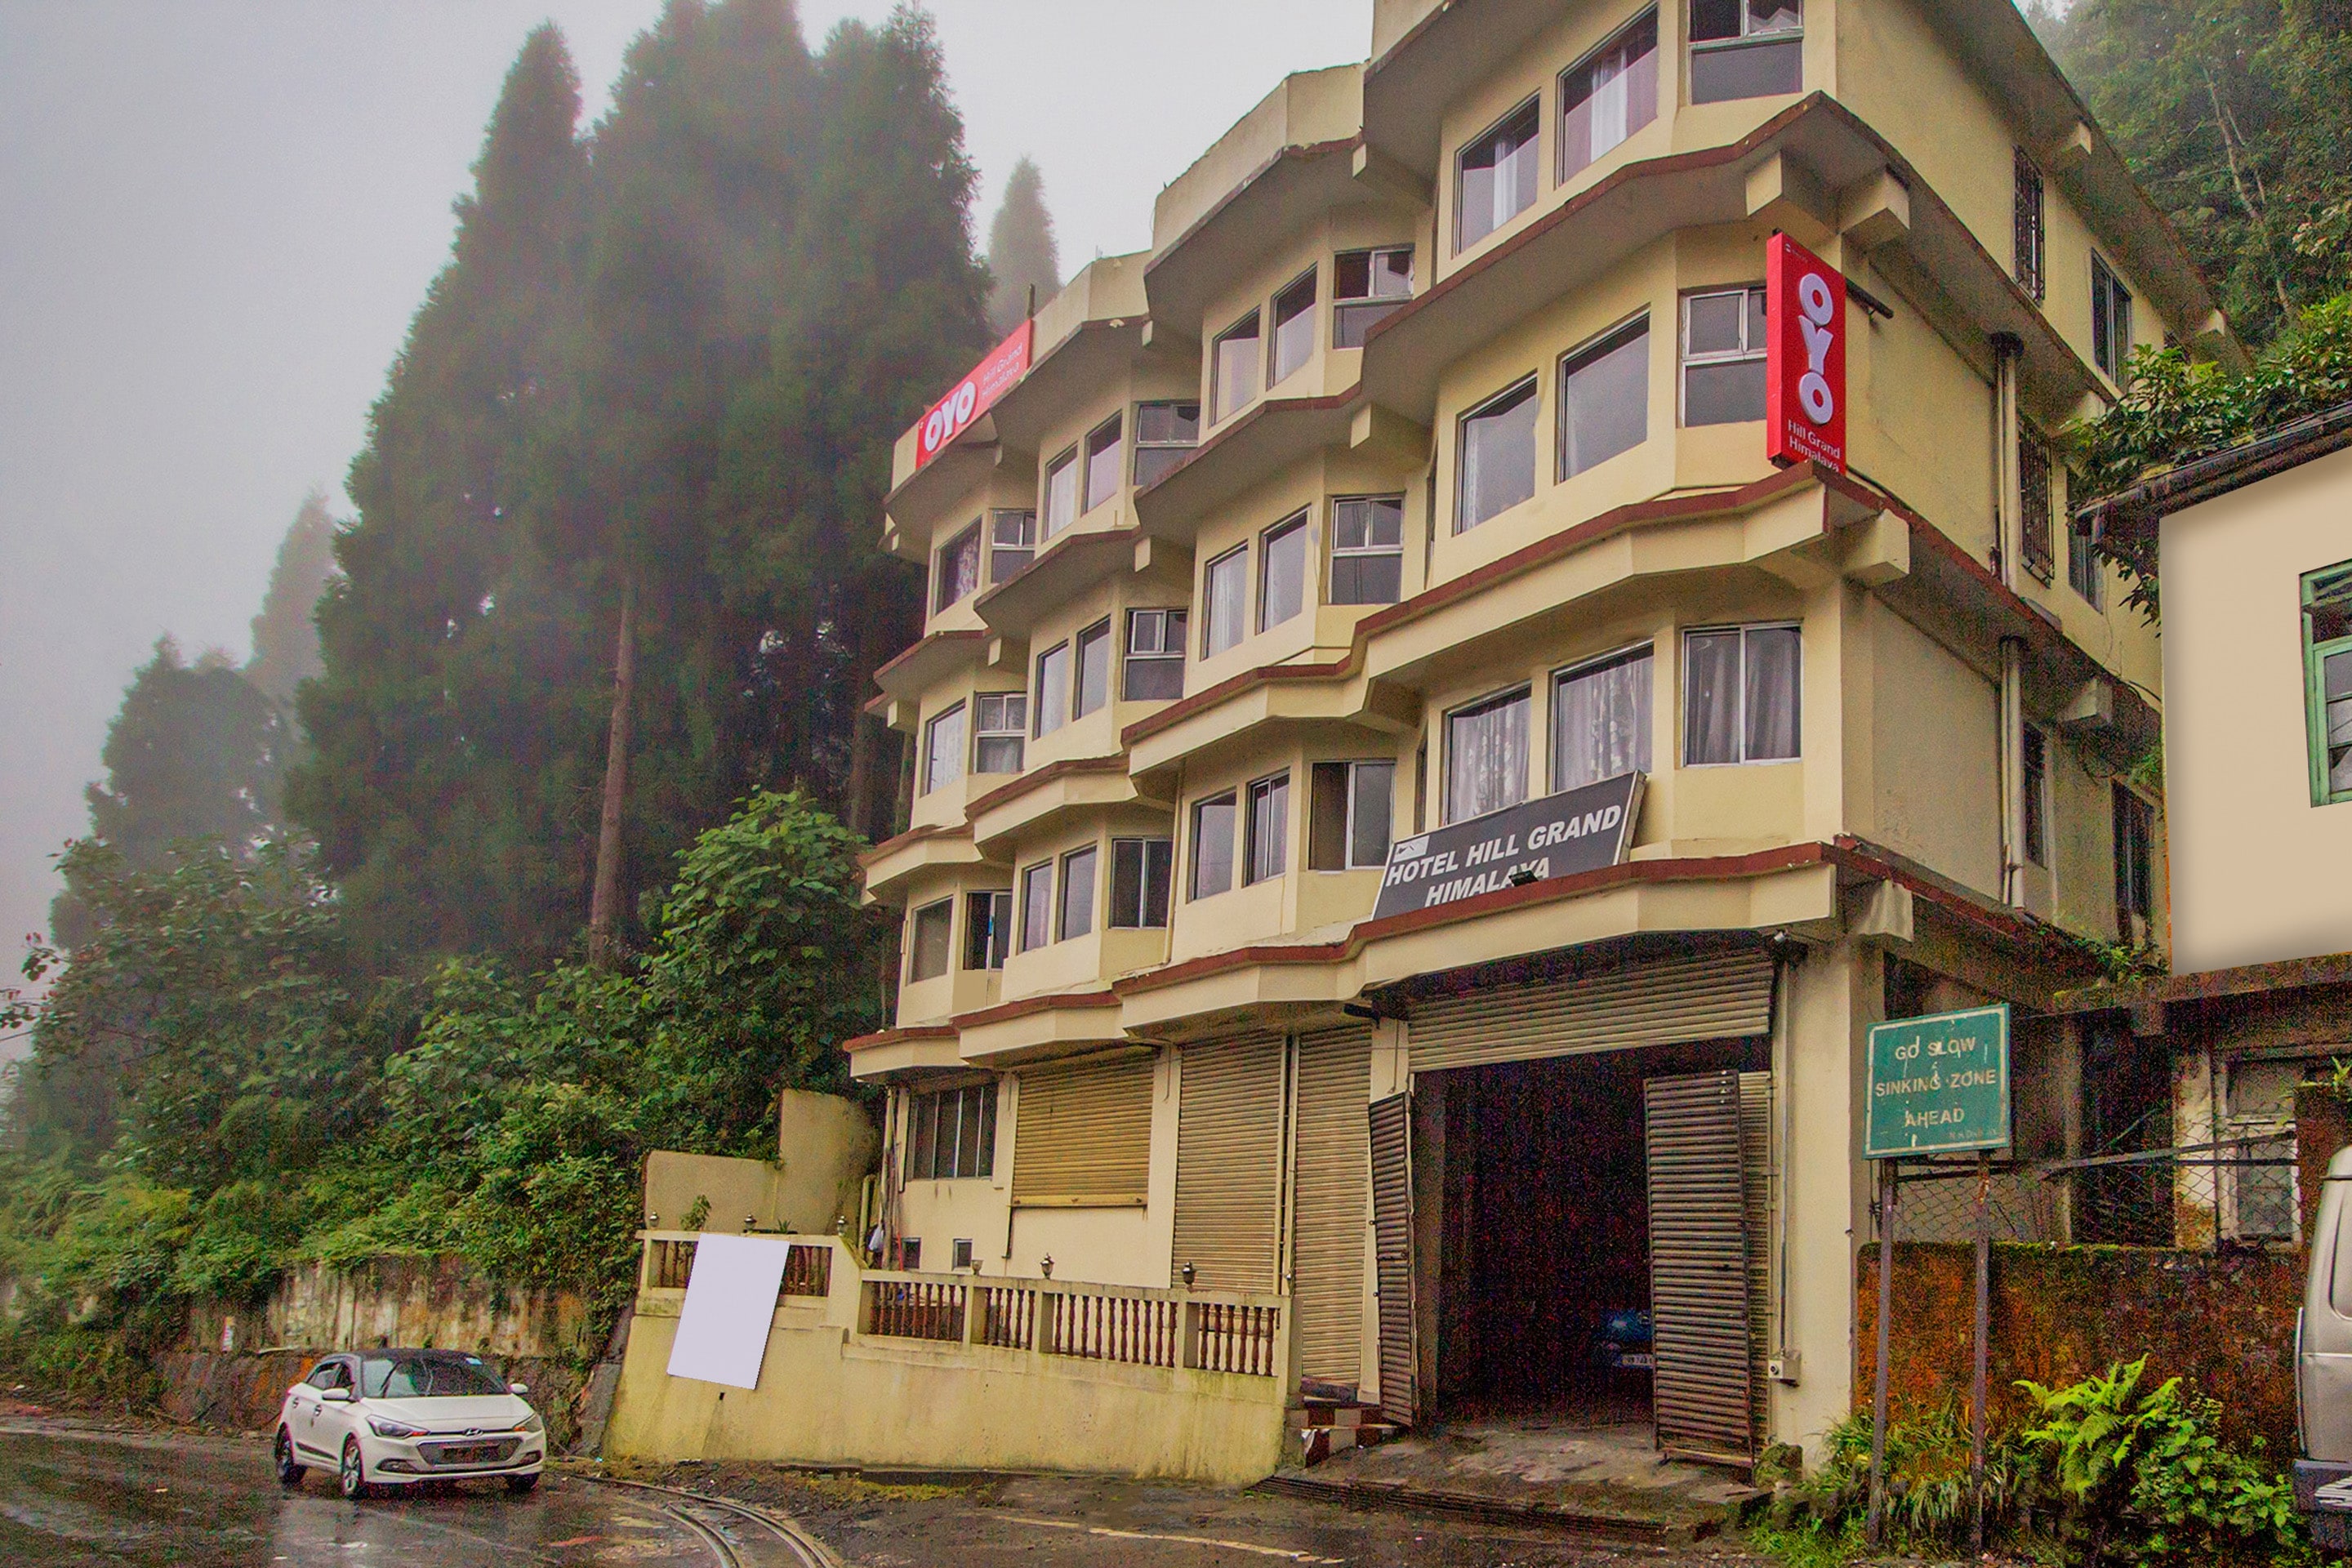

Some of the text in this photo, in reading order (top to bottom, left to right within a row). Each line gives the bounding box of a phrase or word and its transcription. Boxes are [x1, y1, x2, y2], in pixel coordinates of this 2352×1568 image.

[1798, 273, 1833, 425] OYO
[924, 381, 976, 452] OYO
[1788, 419, 1841, 459] Hill Grand
[1385, 804, 1622, 887] HOTEL HILL GRAND
[1895, 1036, 1976, 1061] GO SLOW
[1875, 1069, 1997, 1097] SINKING ZONE
[1904, 1108, 1965, 1128] AHEAD
